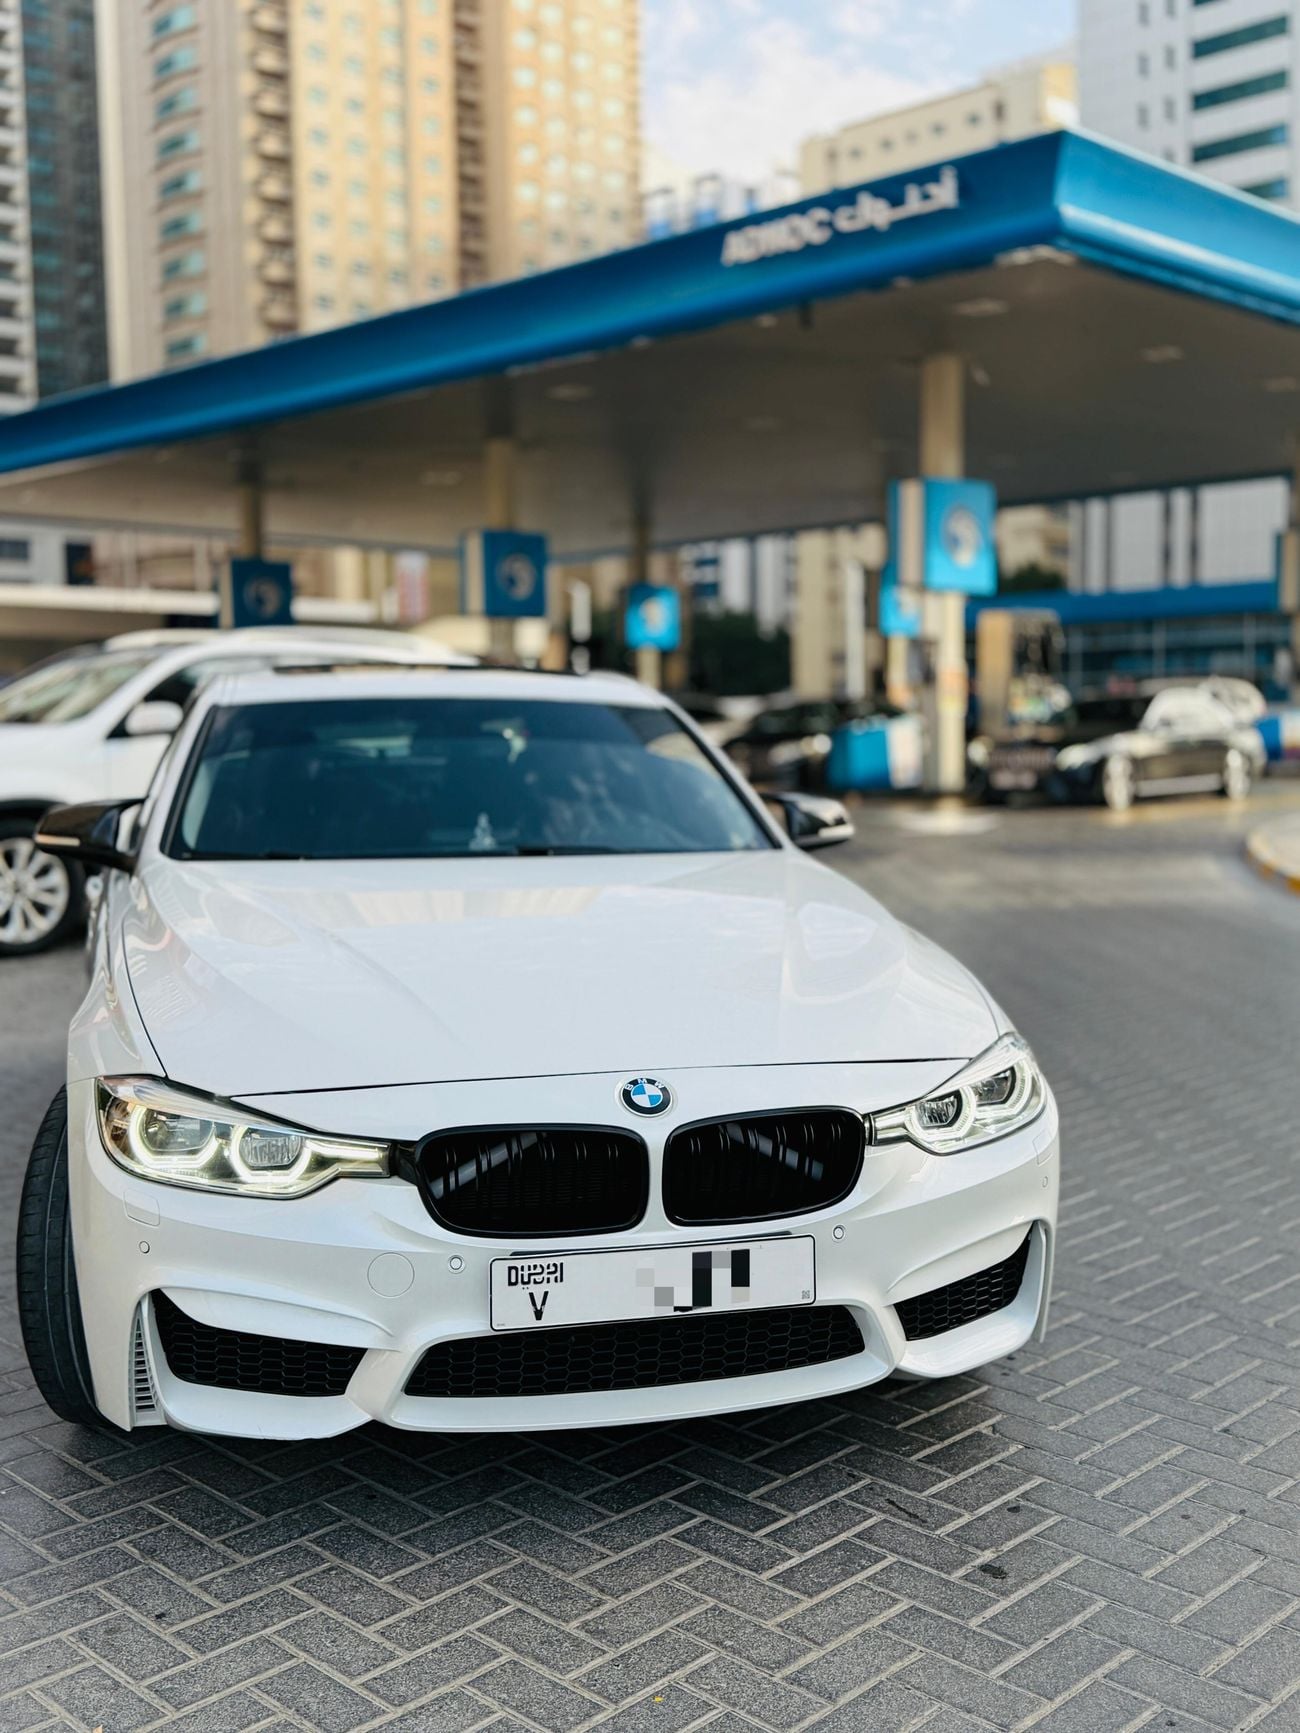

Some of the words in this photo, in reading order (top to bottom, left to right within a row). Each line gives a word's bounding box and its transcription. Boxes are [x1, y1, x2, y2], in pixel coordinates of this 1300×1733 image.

[624, 1078, 664, 1090] BMW
[507, 1262, 563, 1287] DUBAI
[528, 1290, 549, 1320] V
